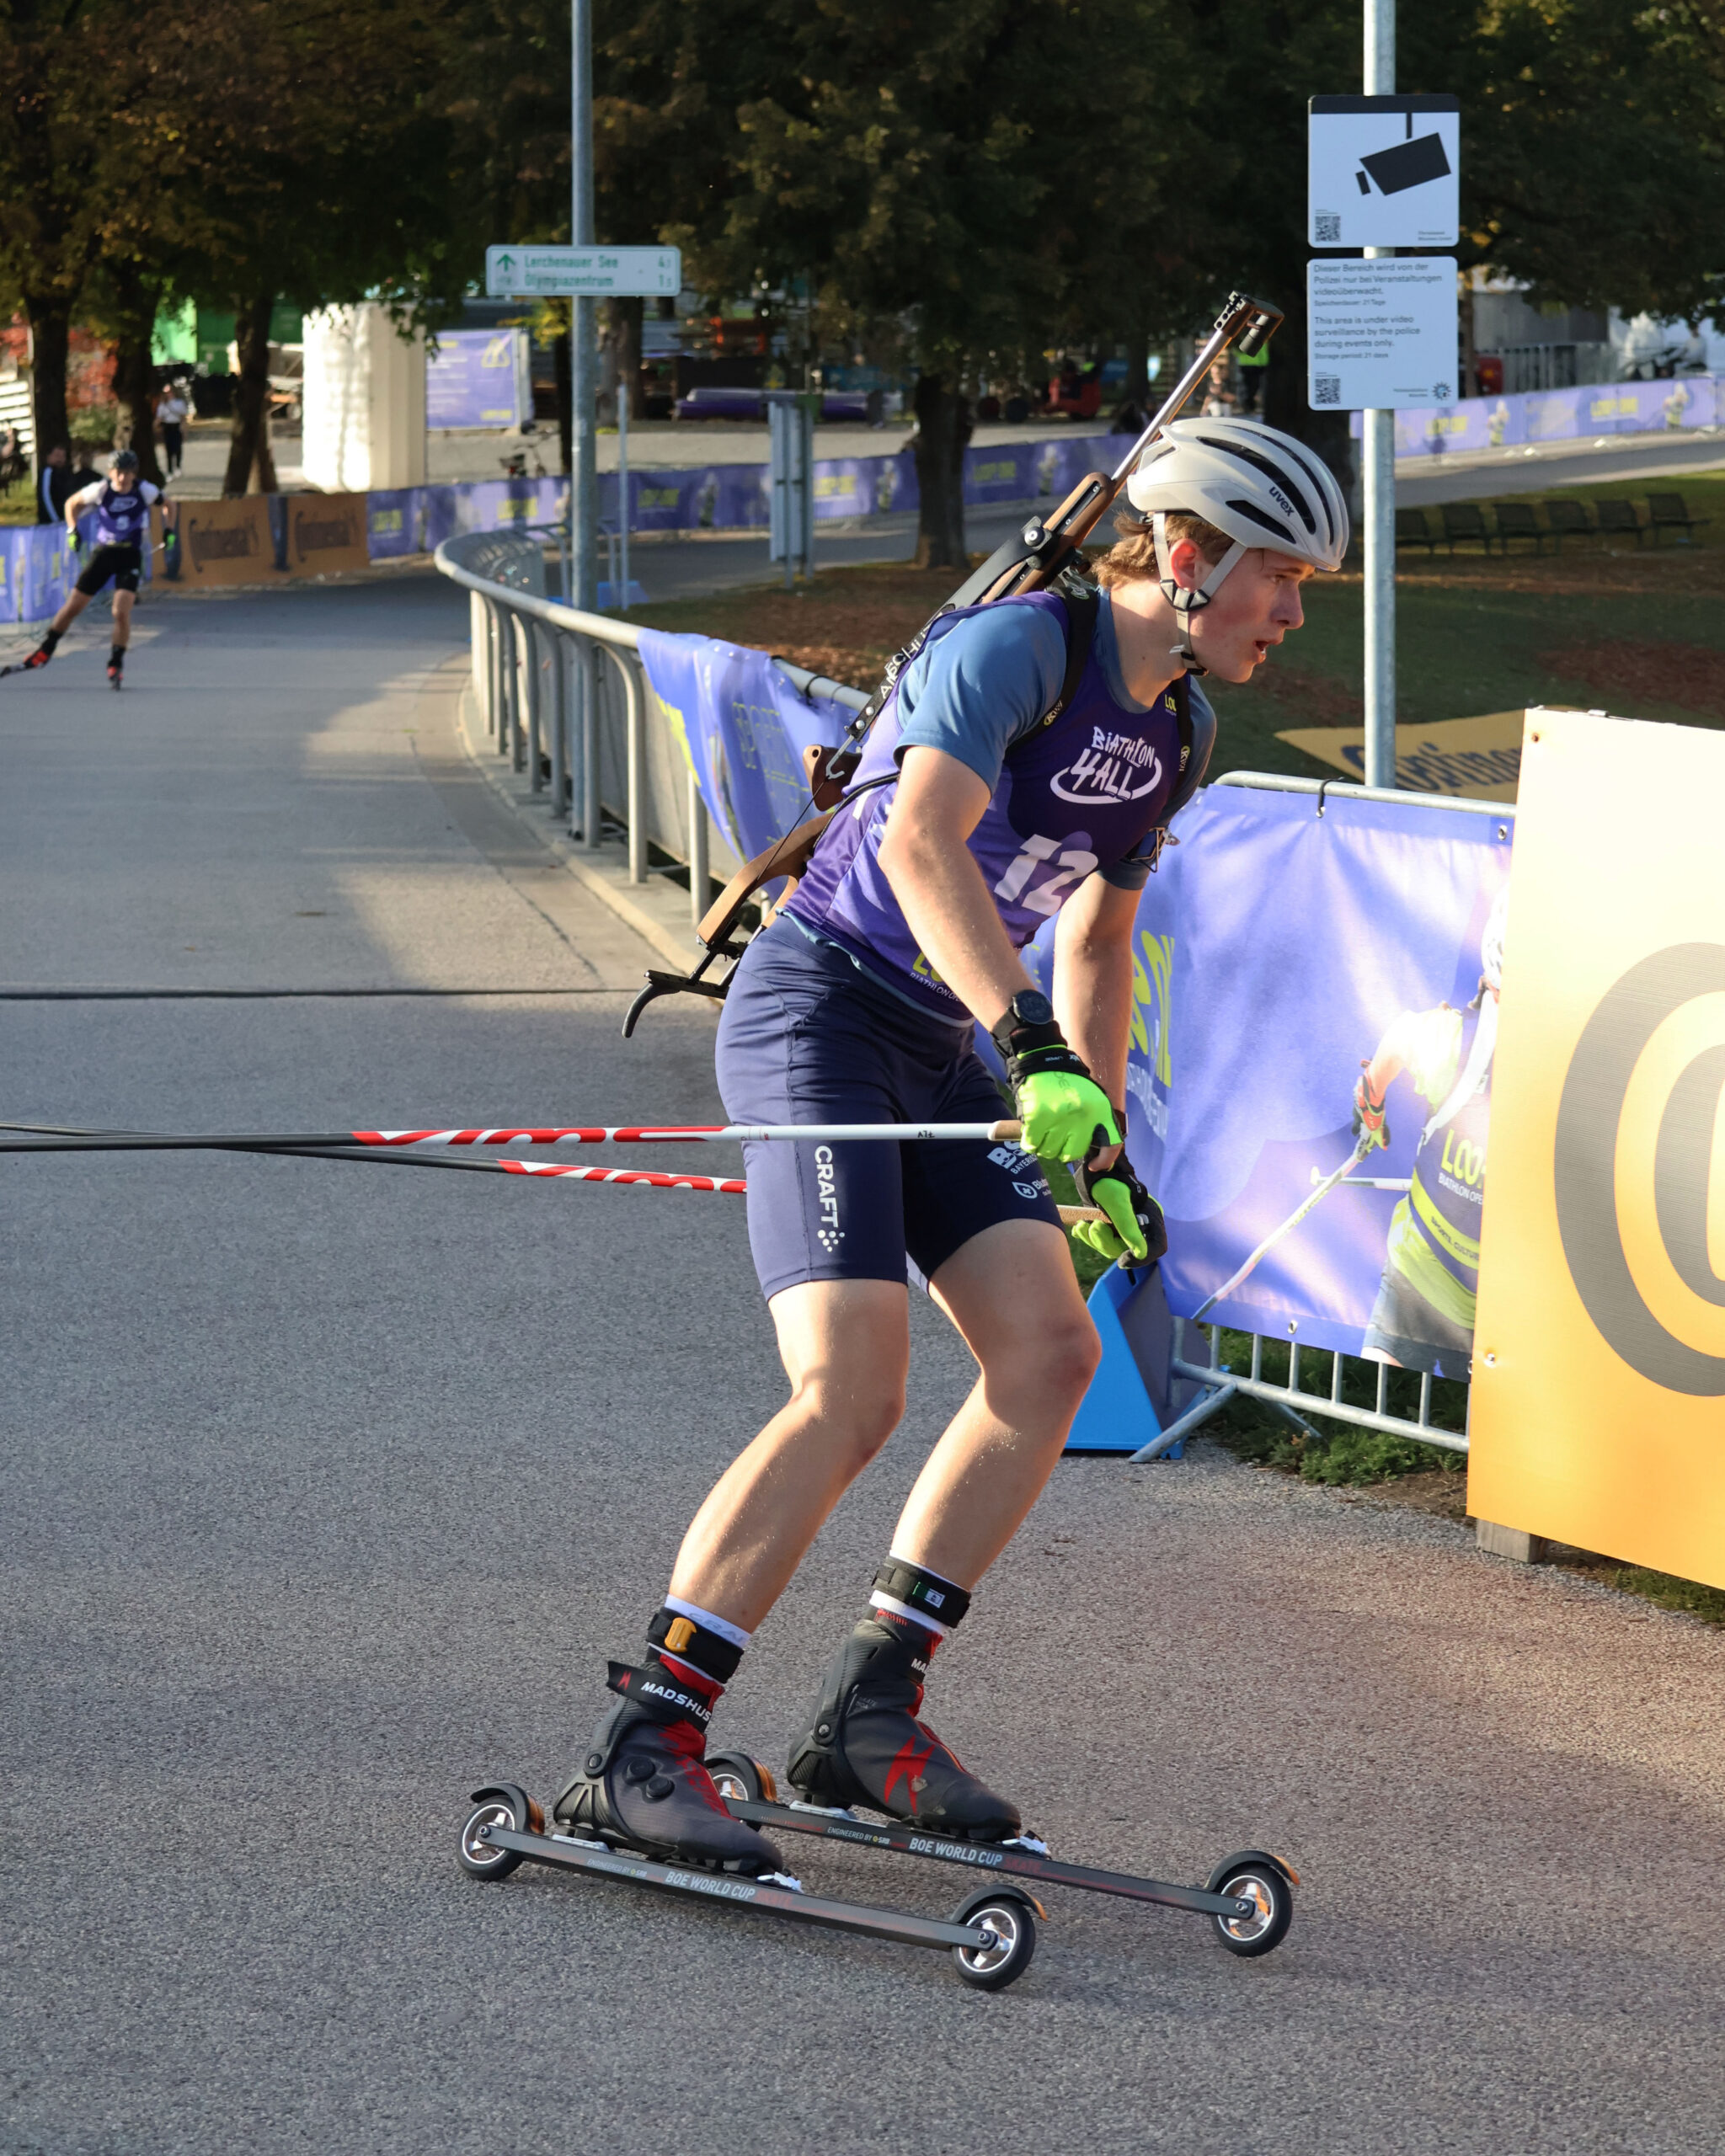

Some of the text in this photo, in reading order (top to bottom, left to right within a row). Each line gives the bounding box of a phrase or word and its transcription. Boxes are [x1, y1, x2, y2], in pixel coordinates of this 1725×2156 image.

[525, 255, 592, 268] Lerchenauer
[598, 255, 618, 268] See
[1343, 264, 1374, 272] Bereich
[1374, 275, 1442, 284] Veranstaltungen
[1315, 328, 1365, 337] surveillance
[1367, 328, 1377, 337] by
[1395, 328, 1420, 336] police
[1315, 340, 1343, 349] during
[1268, 487, 1295, 516] uvex
[994, 834, 1098, 915] 12
[814, 1145, 838, 1228] CRAFT
[1438, 1171, 1470, 1200] BIATHLON
[641, 1681, 712, 1721] MADSHUS
[827, 1827, 864, 1841] ENGINEERED
[864, 1833, 873, 1841] BY
[909, 1837, 934, 1854] BOE
[935, 1842, 977, 1861] WORLD
[978, 1852, 1003, 1866] CUP
[586, 1858, 622, 1873] ENGINEERED
[623, 1865, 632, 1874] BY
[665, 1870, 687, 1886] BOE
[690, 1876, 730, 1895] WORLD
[731, 1884, 756, 1900] CUP
